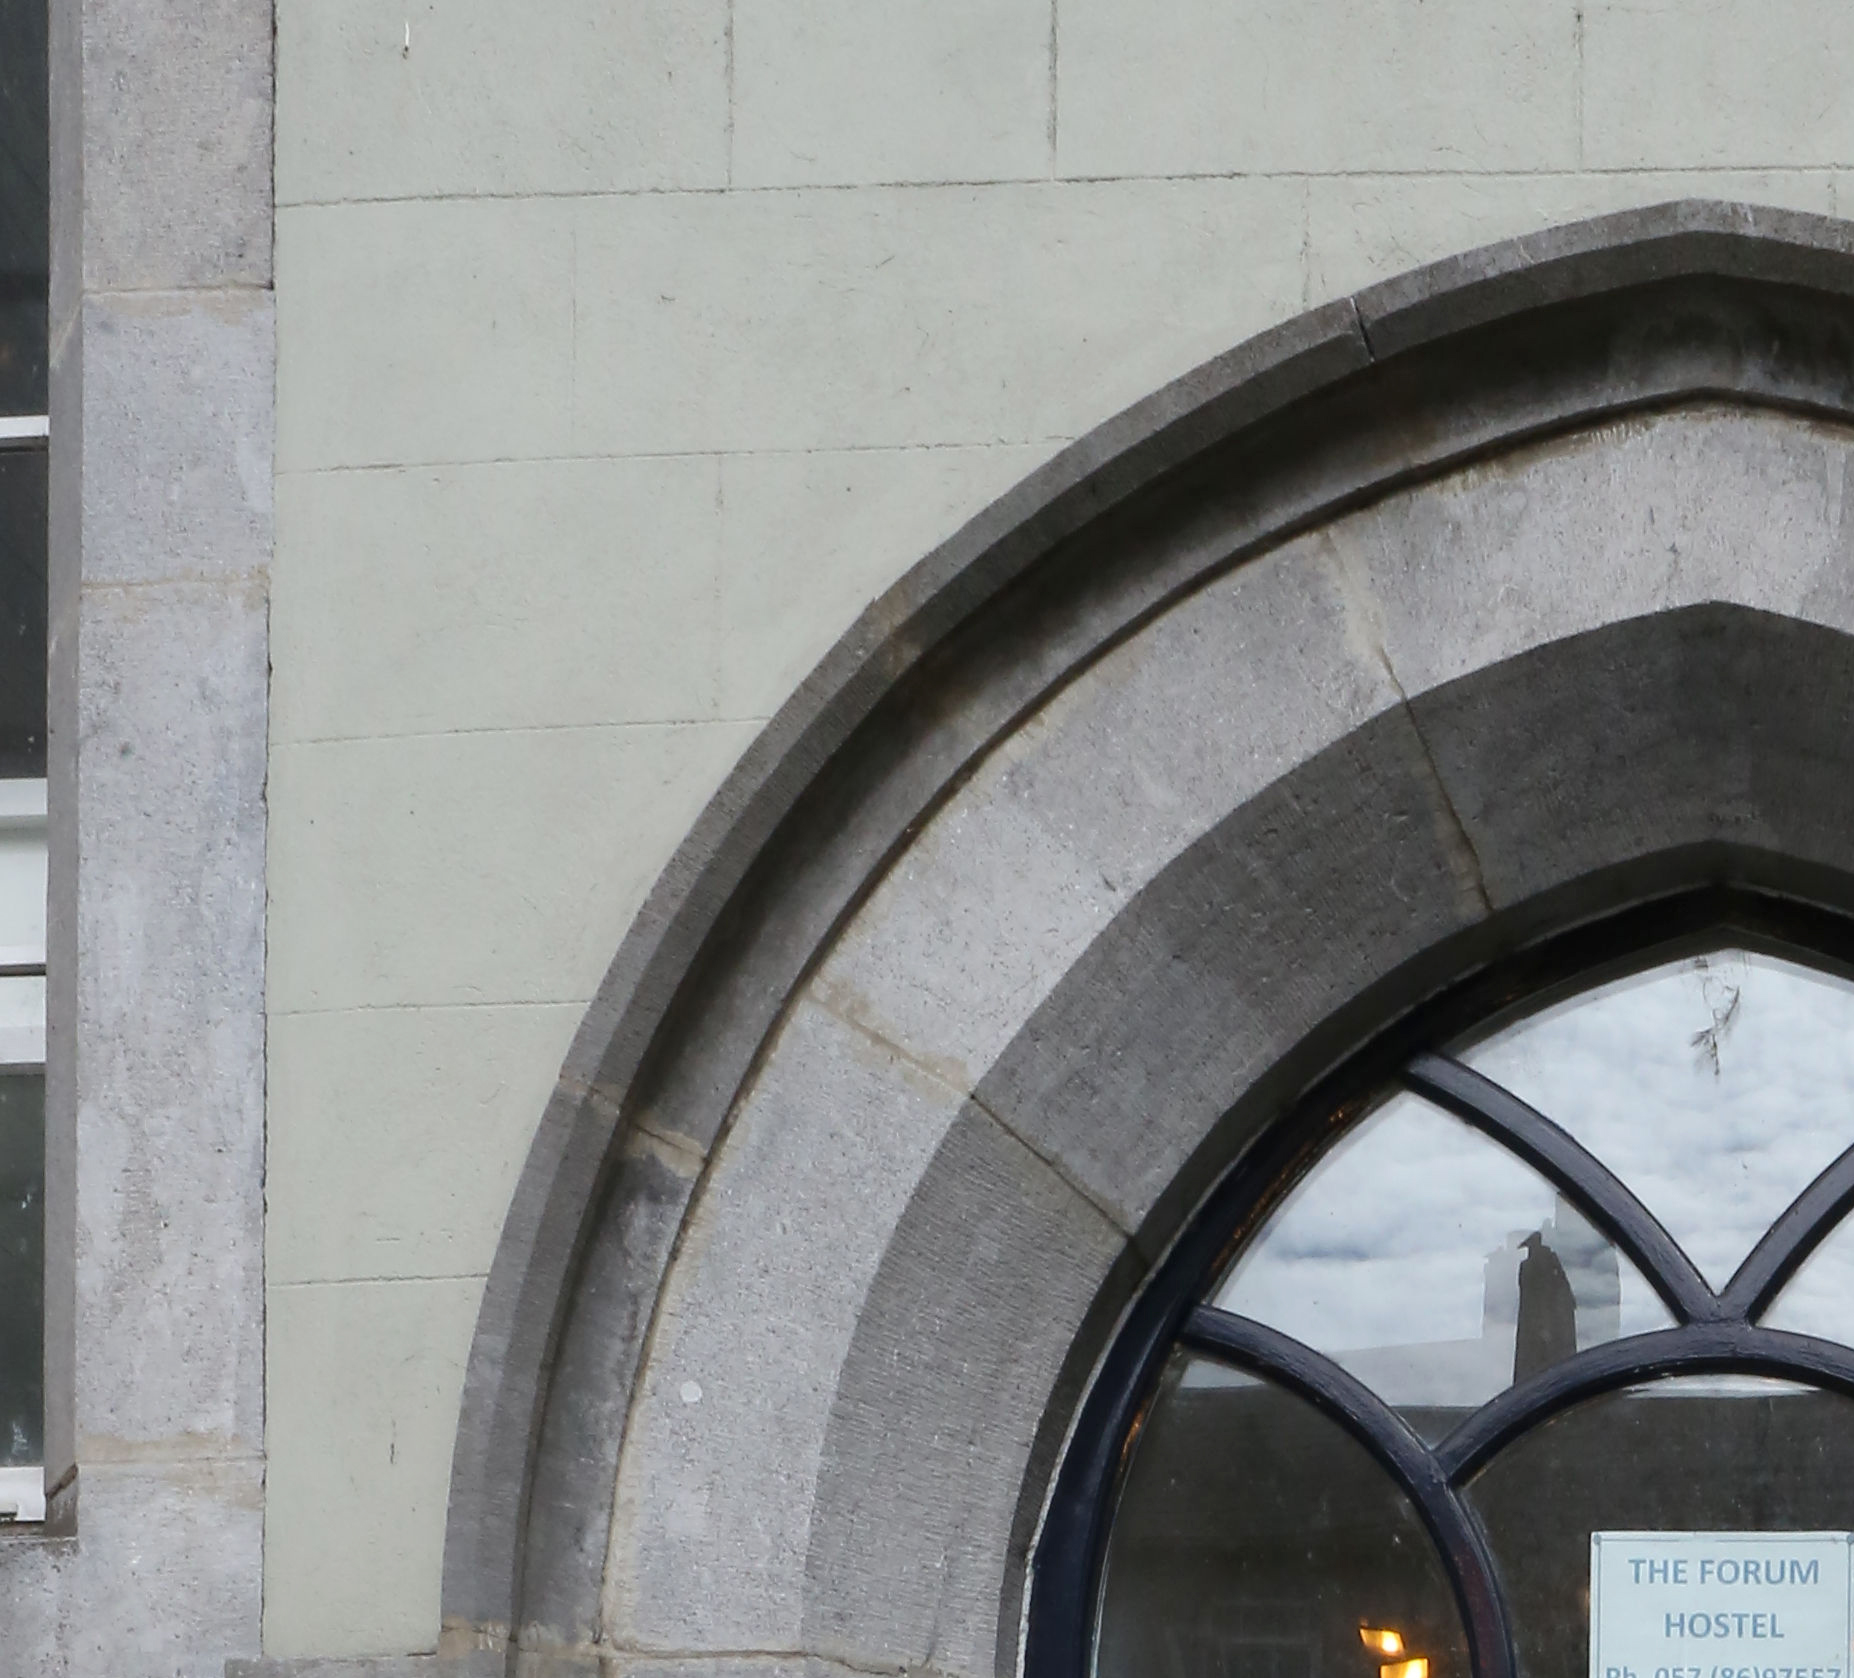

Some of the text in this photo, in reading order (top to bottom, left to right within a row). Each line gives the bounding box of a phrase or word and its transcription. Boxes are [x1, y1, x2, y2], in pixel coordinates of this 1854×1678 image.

[1628, 1558, 1820, 1586] THE FORUM
[1664, 1612, 1785, 1639] HOSTEL
